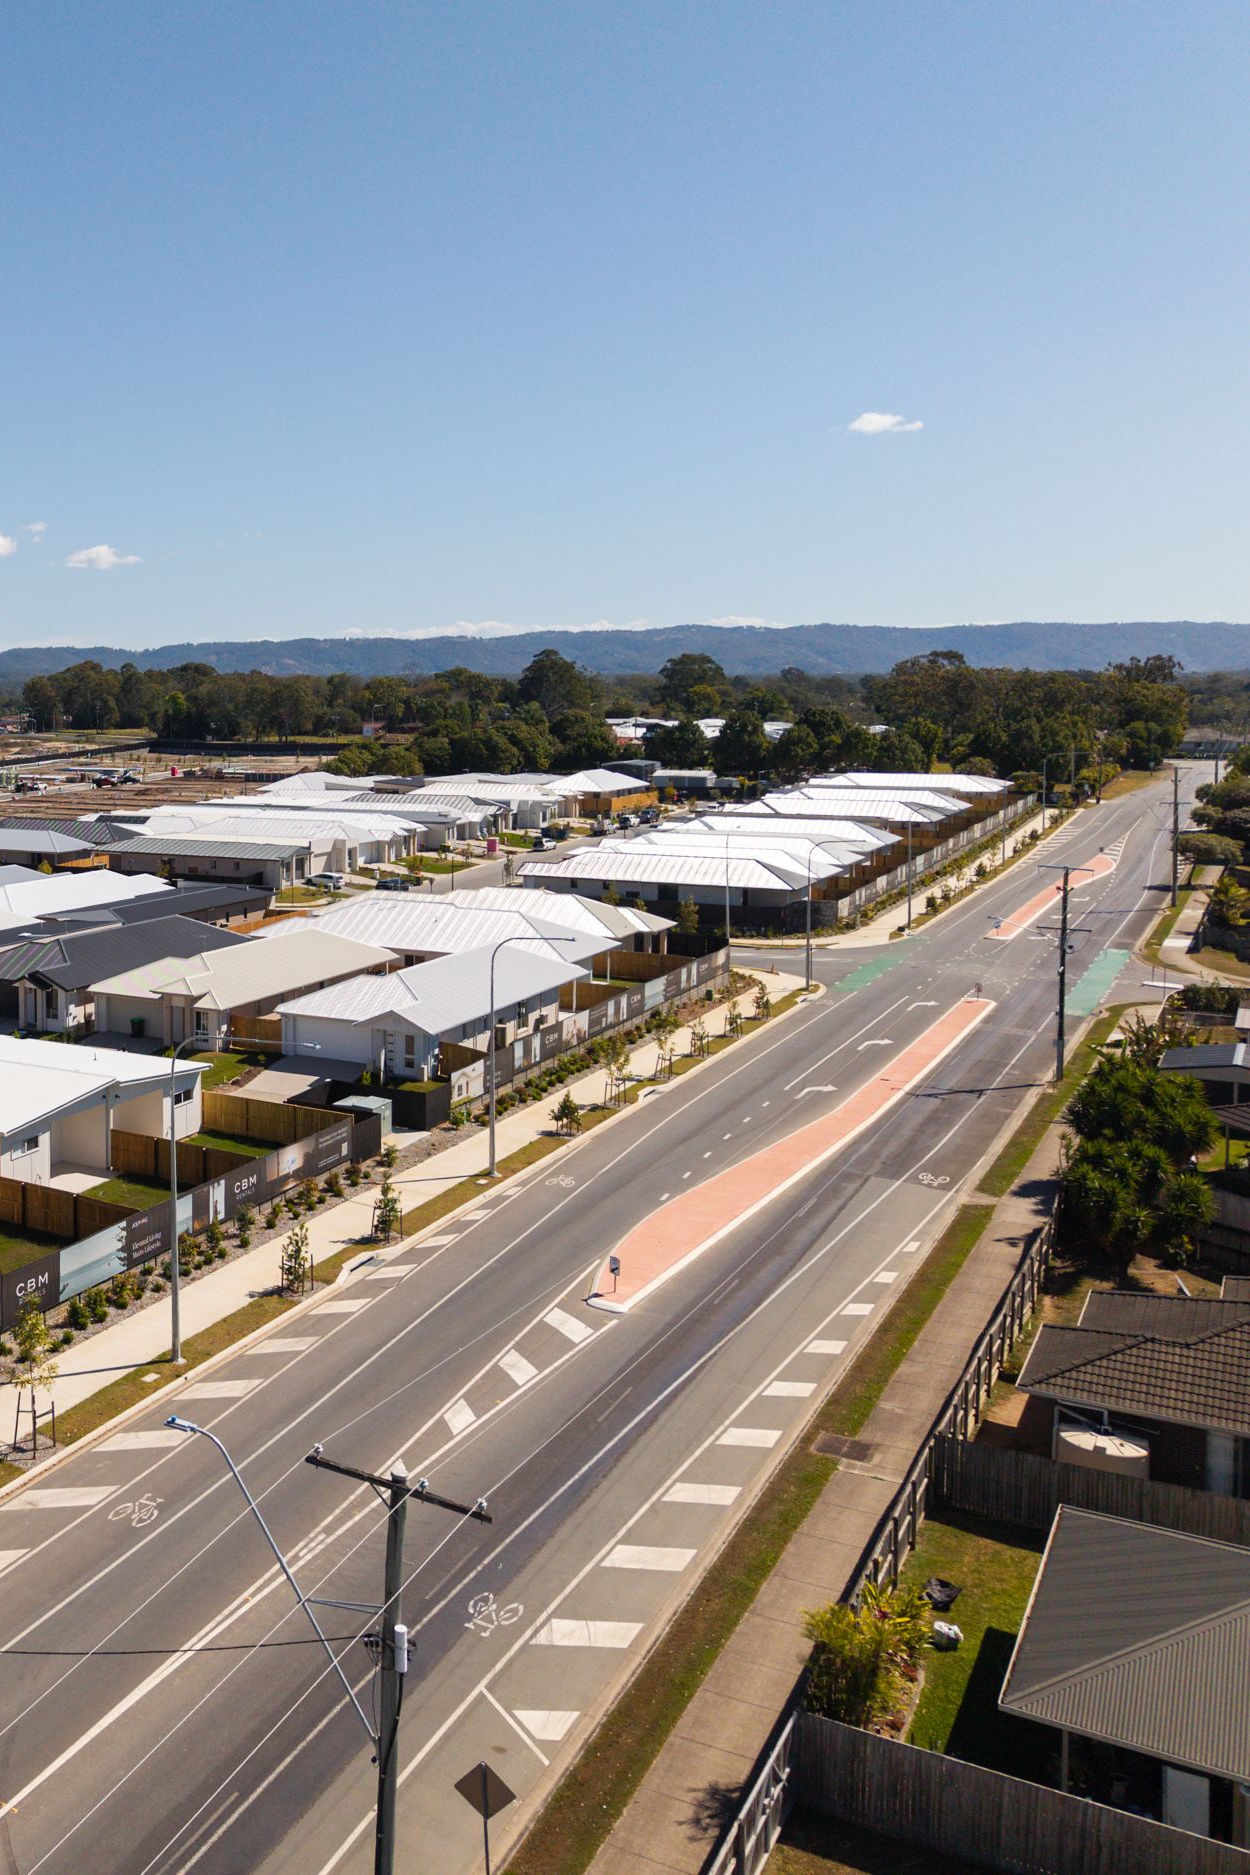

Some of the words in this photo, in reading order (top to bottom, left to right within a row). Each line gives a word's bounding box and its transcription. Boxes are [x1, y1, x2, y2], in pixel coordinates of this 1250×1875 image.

[545, 1032, 559, 1044] CBM
[234, 1174, 257, 1193] CBM
[16, 1272, 49, 1296] CBM
